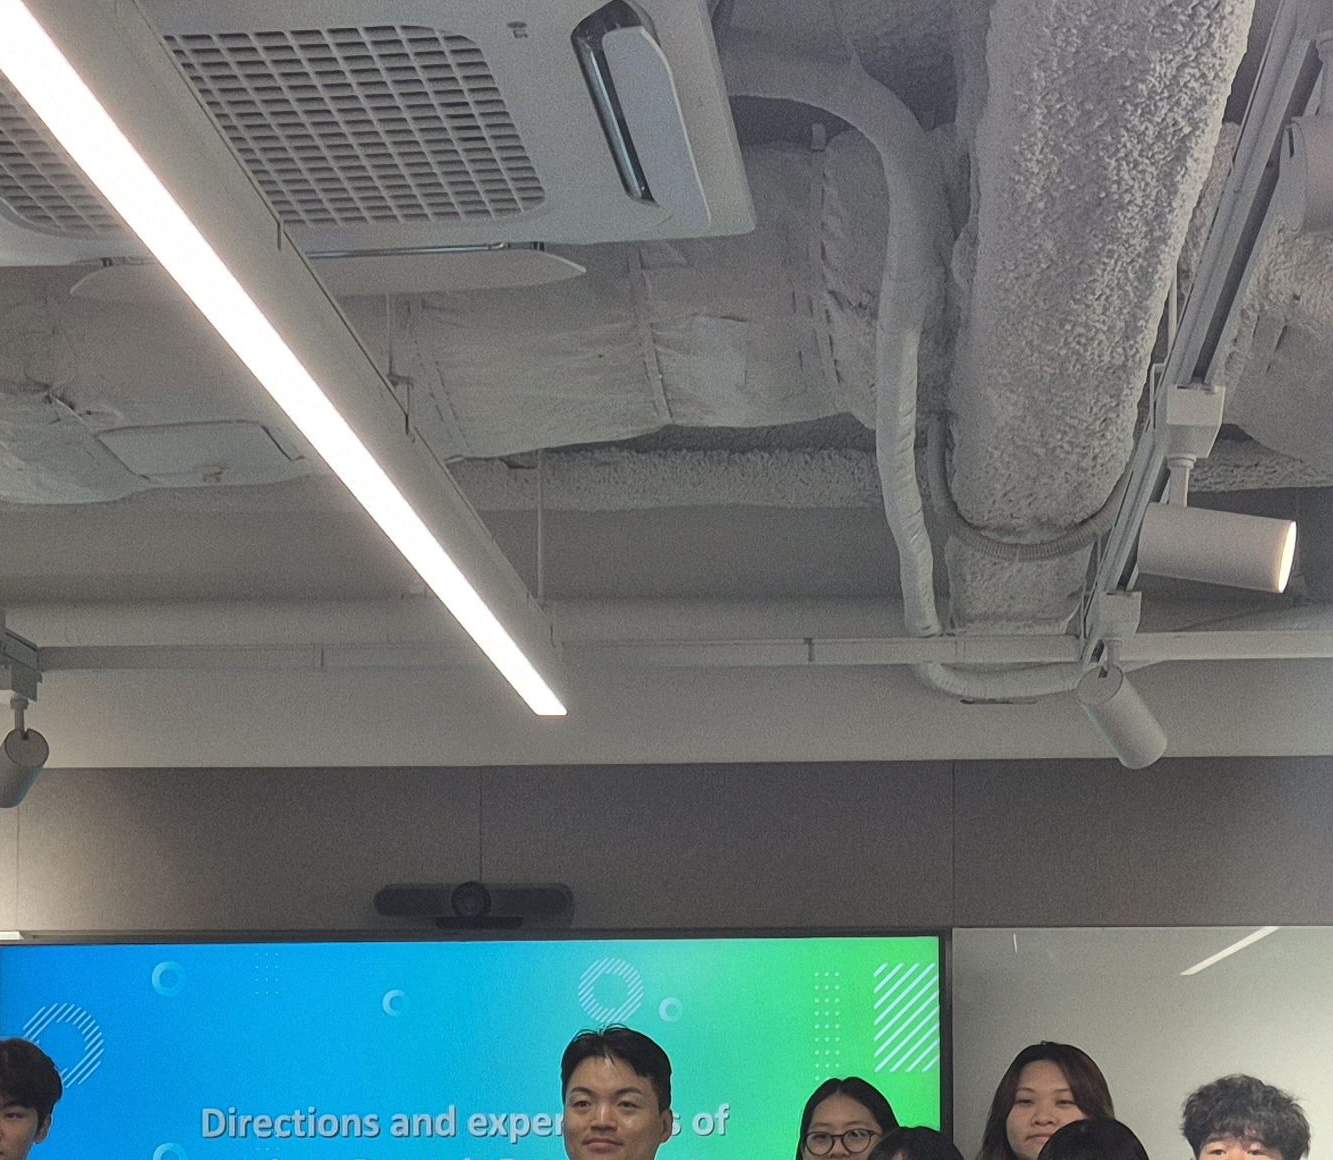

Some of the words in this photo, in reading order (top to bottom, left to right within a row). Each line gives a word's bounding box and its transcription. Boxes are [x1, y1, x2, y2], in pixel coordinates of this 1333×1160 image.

[201, 1106, 380, 1138] Directions
[390, 1105, 457, 1137] and
[693, 1104, 730, 1136] of
